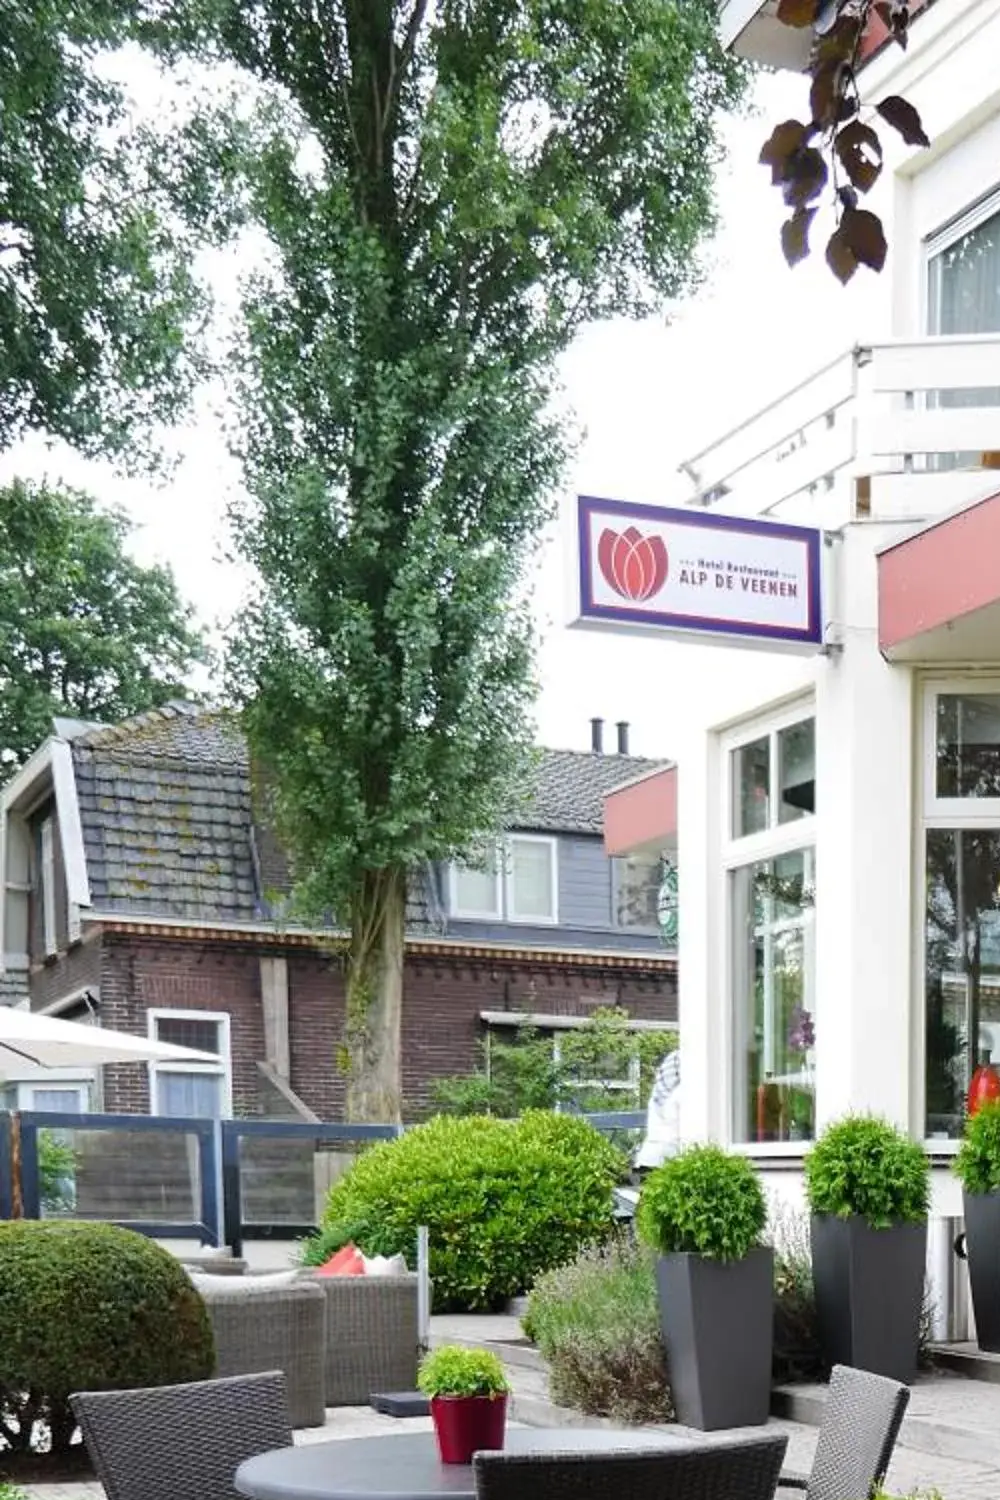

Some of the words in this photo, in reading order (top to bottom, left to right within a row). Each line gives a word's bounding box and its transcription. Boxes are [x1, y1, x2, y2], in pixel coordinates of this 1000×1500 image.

[679, 569, 707, 586] ALP
[715, 573, 733, 590] DE
[740, 576, 798, 598] VEENEN
